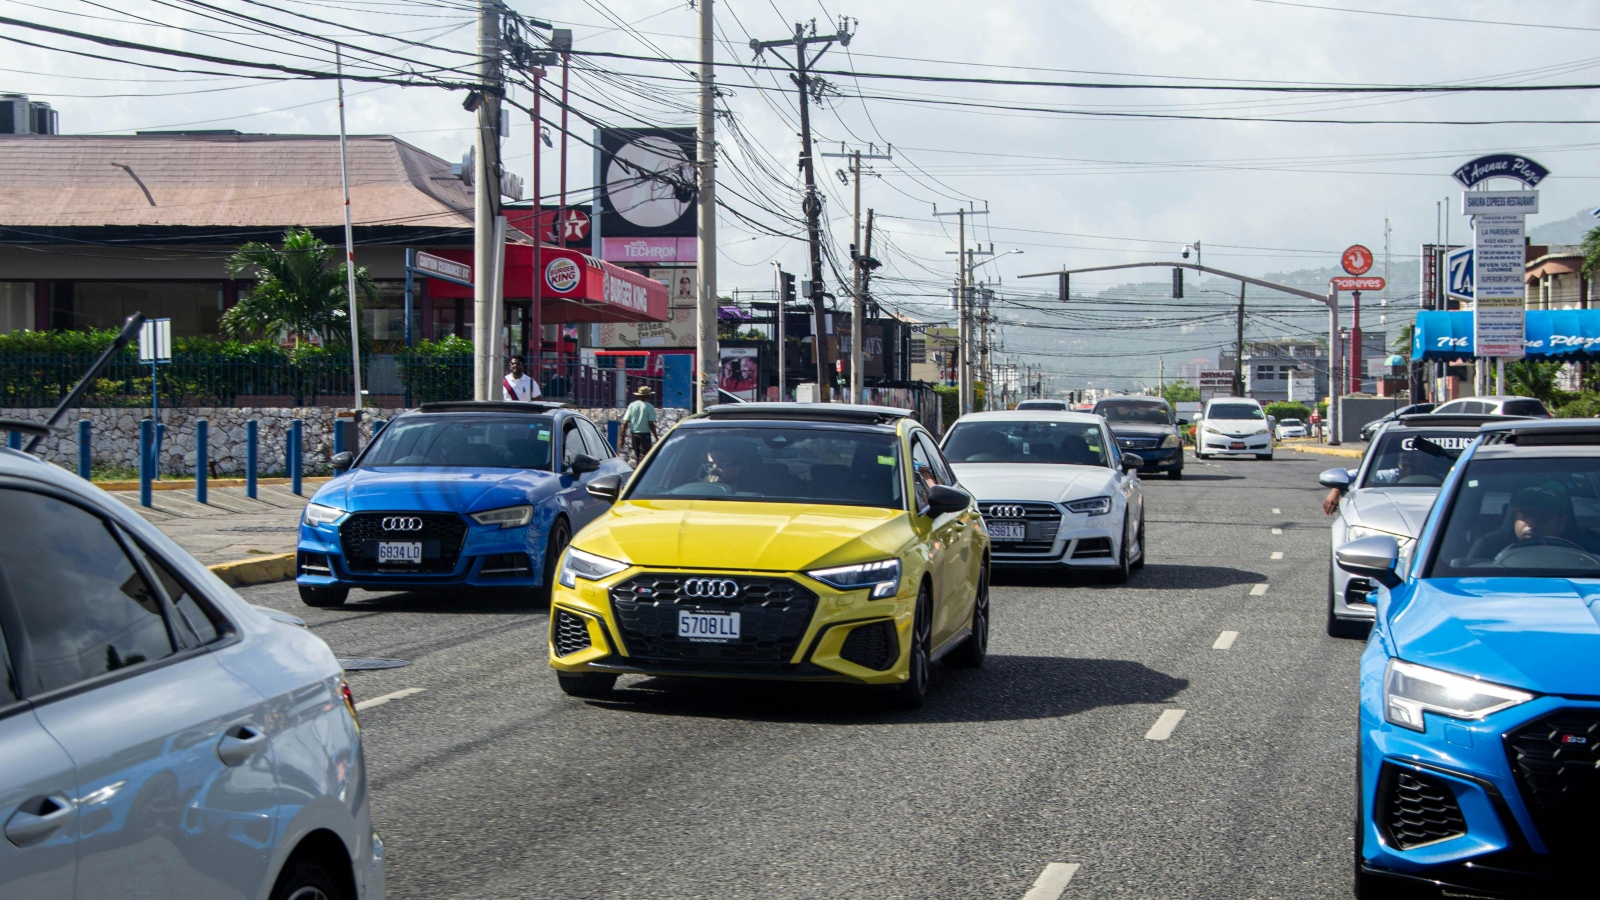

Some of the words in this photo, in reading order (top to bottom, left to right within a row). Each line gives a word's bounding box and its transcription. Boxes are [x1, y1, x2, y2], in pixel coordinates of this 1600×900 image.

[1471, 161, 1508, 182] Avenue
[1512, 158, 1540, 182] Plaza
[1468, 197, 1486, 207] SAKURA
[1486, 196, 1506, 206] EXPRESS
[1506, 196, 1535, 206] RESTAURANT
[624, 245, 676, 259] TECHRON
[550, 266, 575, 276] BURGER
[1451, 253, 1470, 290] 7
[550, 272, 576, 284] KING
[610, 276, 632, 307] BURGER
[633, 284, 647, 312] KING
[1437, 336, 1469, 347] 7th
